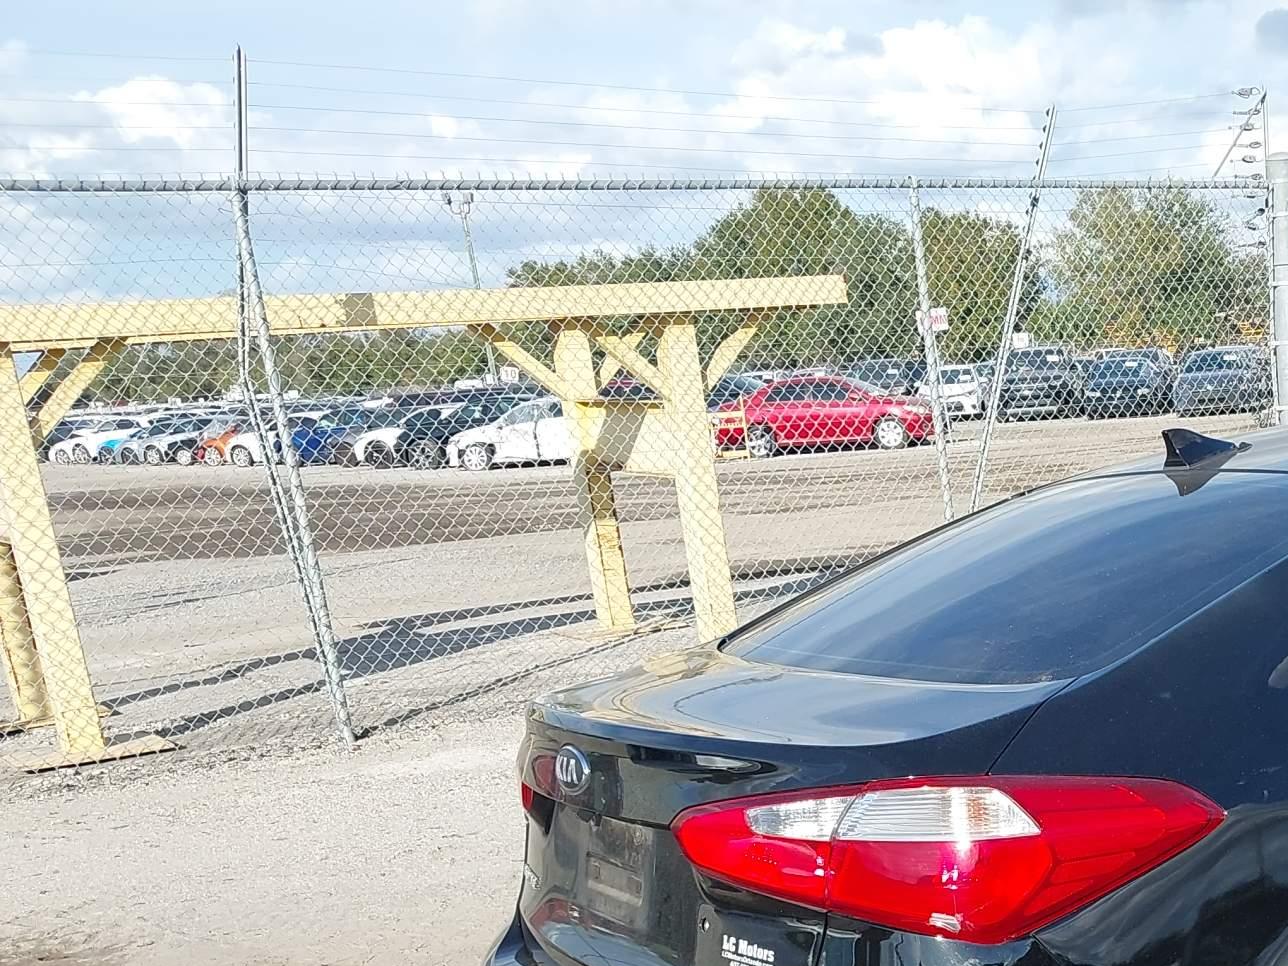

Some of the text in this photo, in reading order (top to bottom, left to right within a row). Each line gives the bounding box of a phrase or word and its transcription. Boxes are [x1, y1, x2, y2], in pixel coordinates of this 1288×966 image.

[556, 755, 579, 785] KIA
[722, 934, 775, 962] LC Motors
